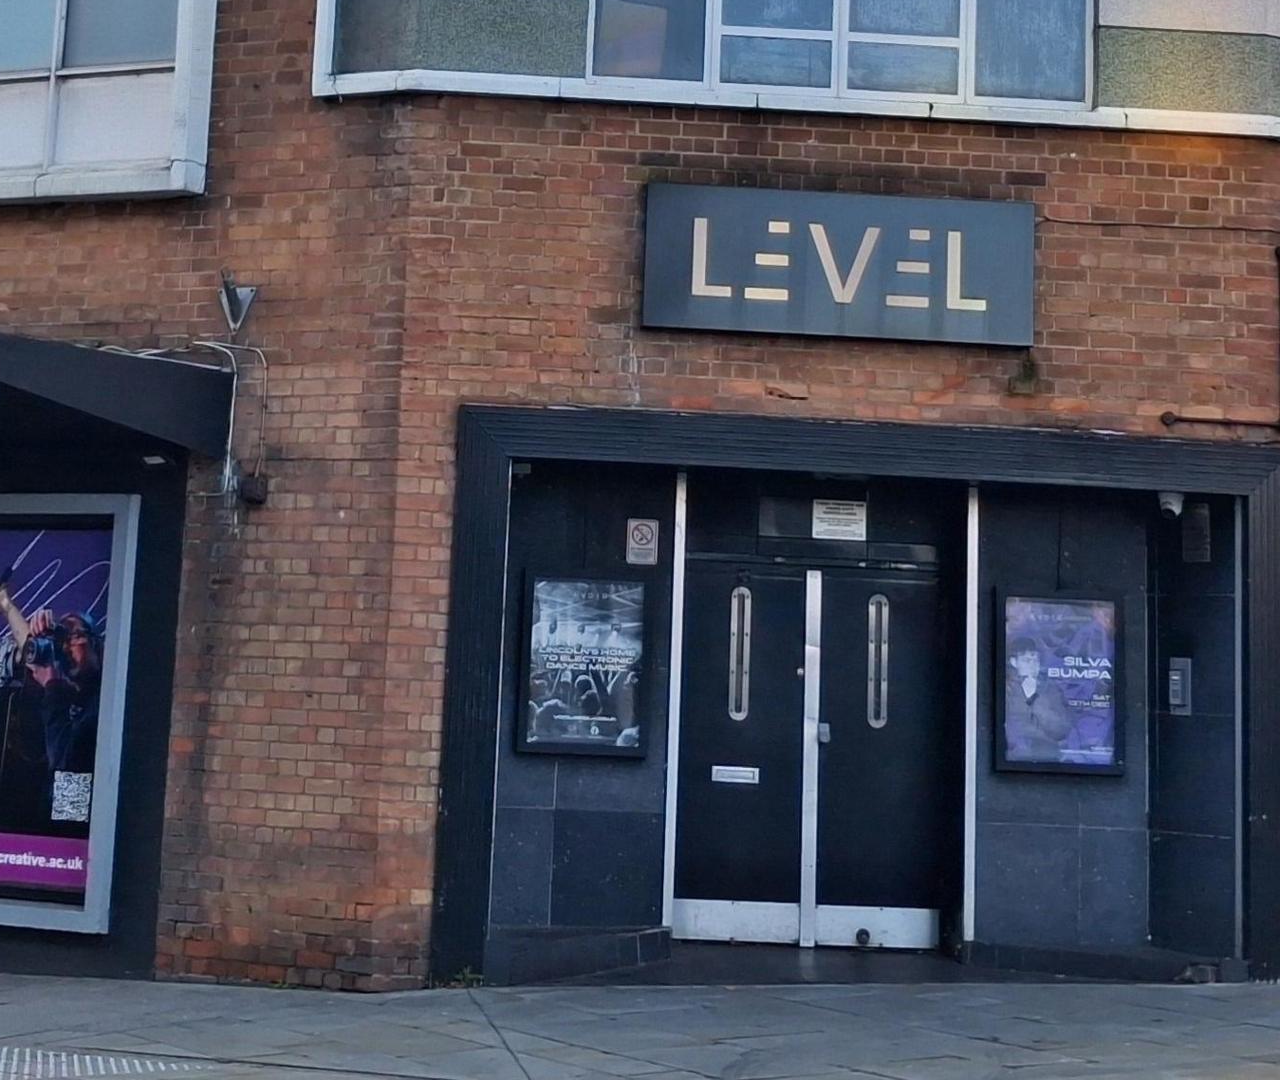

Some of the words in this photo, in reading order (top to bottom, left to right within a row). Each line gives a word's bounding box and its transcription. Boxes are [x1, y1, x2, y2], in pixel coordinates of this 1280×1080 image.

[691, 217, 987, 311] LEVEL
[539, 646, 600, 656] LINCOLN'S
[601, 648, 636, 657] HOME
[541, 654, 558, 662] TO
[560, 655, 634, 664] ELECTRONIC
[1063, 656, 1112, 668] SILVA
[546, 662, 587, 670] DANCE
[1047, 668, 1112, 680] BUMPA
